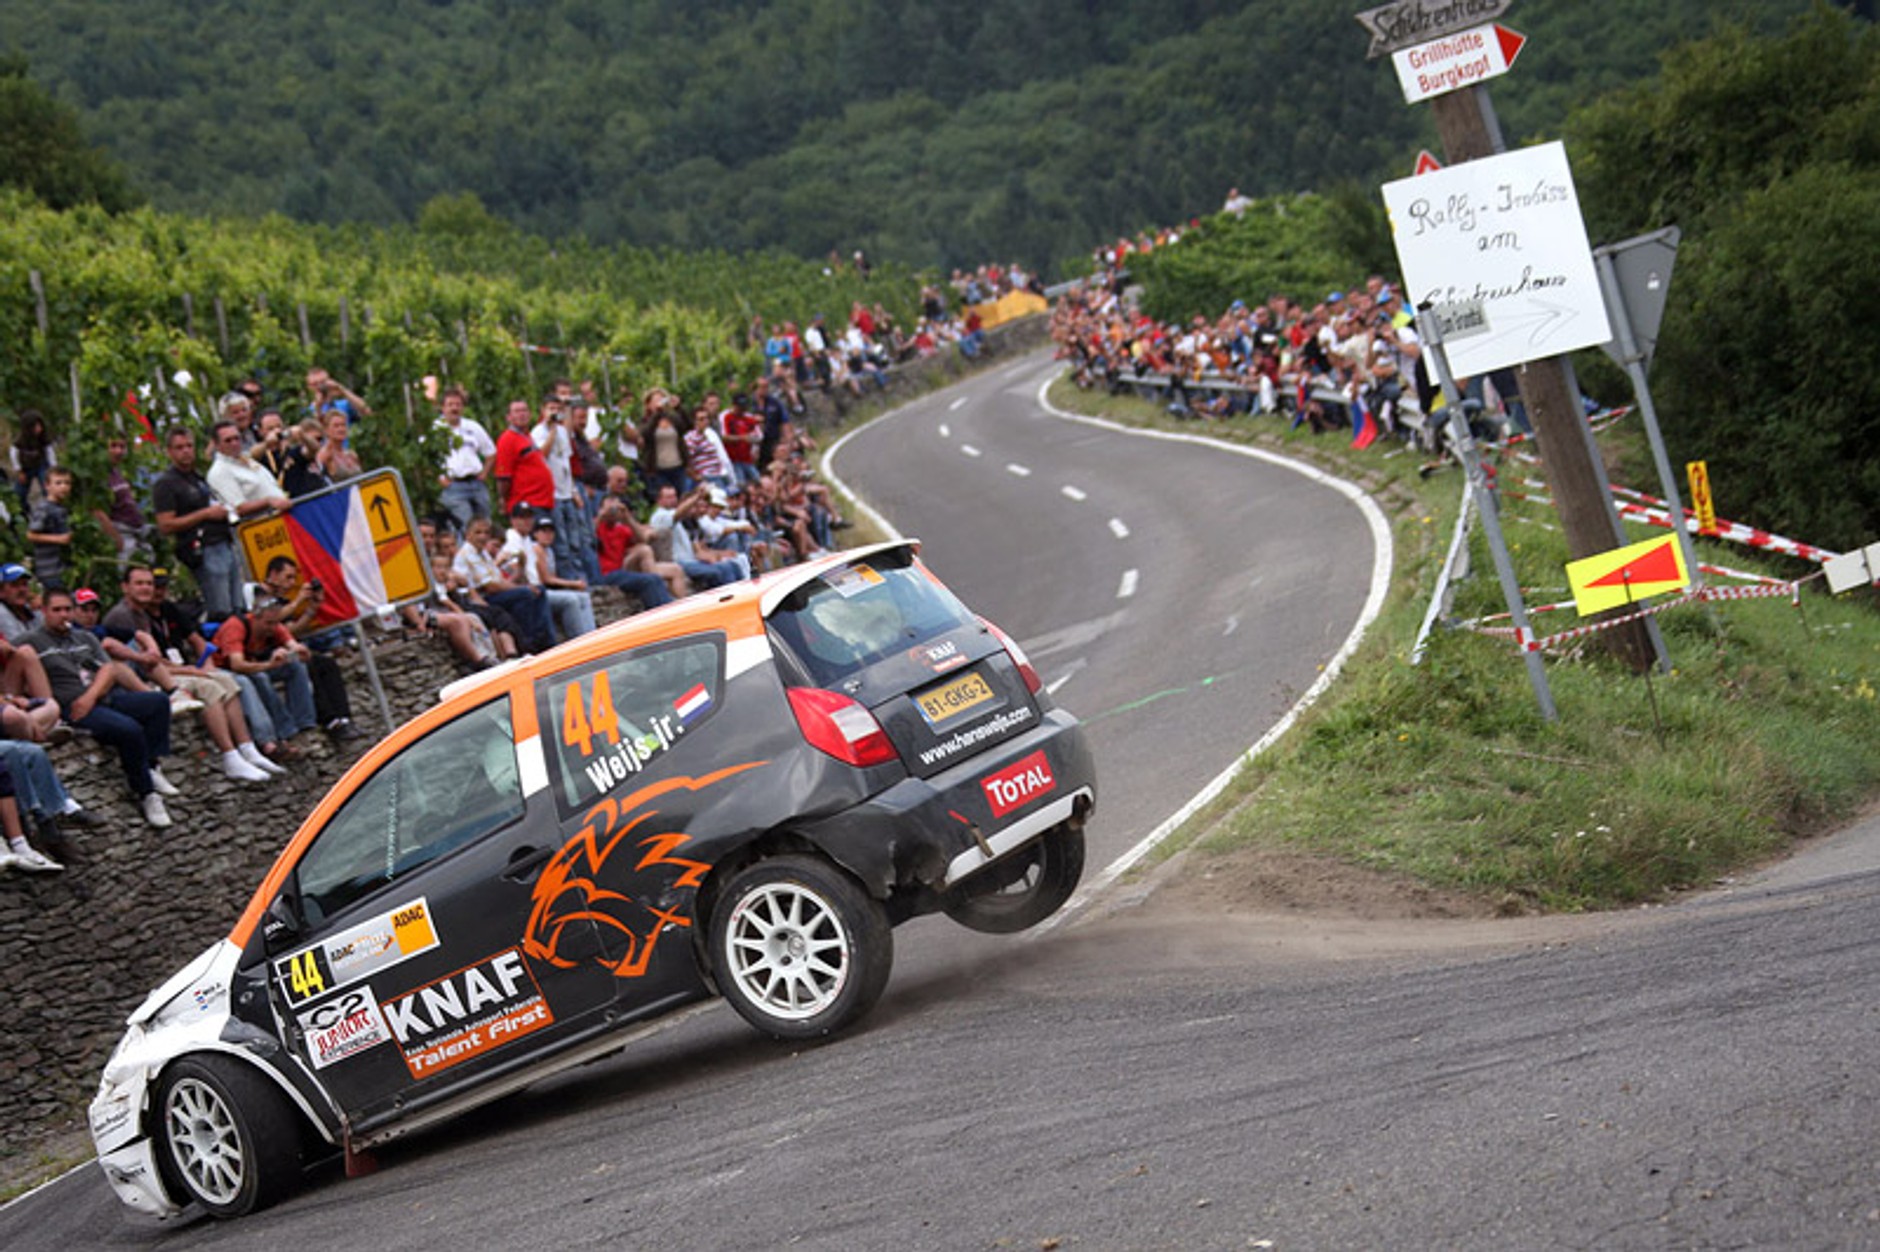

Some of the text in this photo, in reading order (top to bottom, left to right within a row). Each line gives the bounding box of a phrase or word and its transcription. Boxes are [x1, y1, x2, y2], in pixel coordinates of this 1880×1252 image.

[1408, 33, 1485, 70] Grillhütte
[1417, 54, 1491, 94] Burgkopf
[1478, 231, 1522, 251] am
[254, 525, 288, 552] Büdl
[563, 670, 620, 757] 44
[585, 734, 652, 794] Weijs
[986, 765, 1052, 807] TOTAL
[394, 906, 425, 930] ADAC
[290, 950, 325, 998] 44
[310, 993, 369, 1030] C2
[383, 950, 525, 1043] KNAF
[410, 1005, 547, 1071] Talent First
